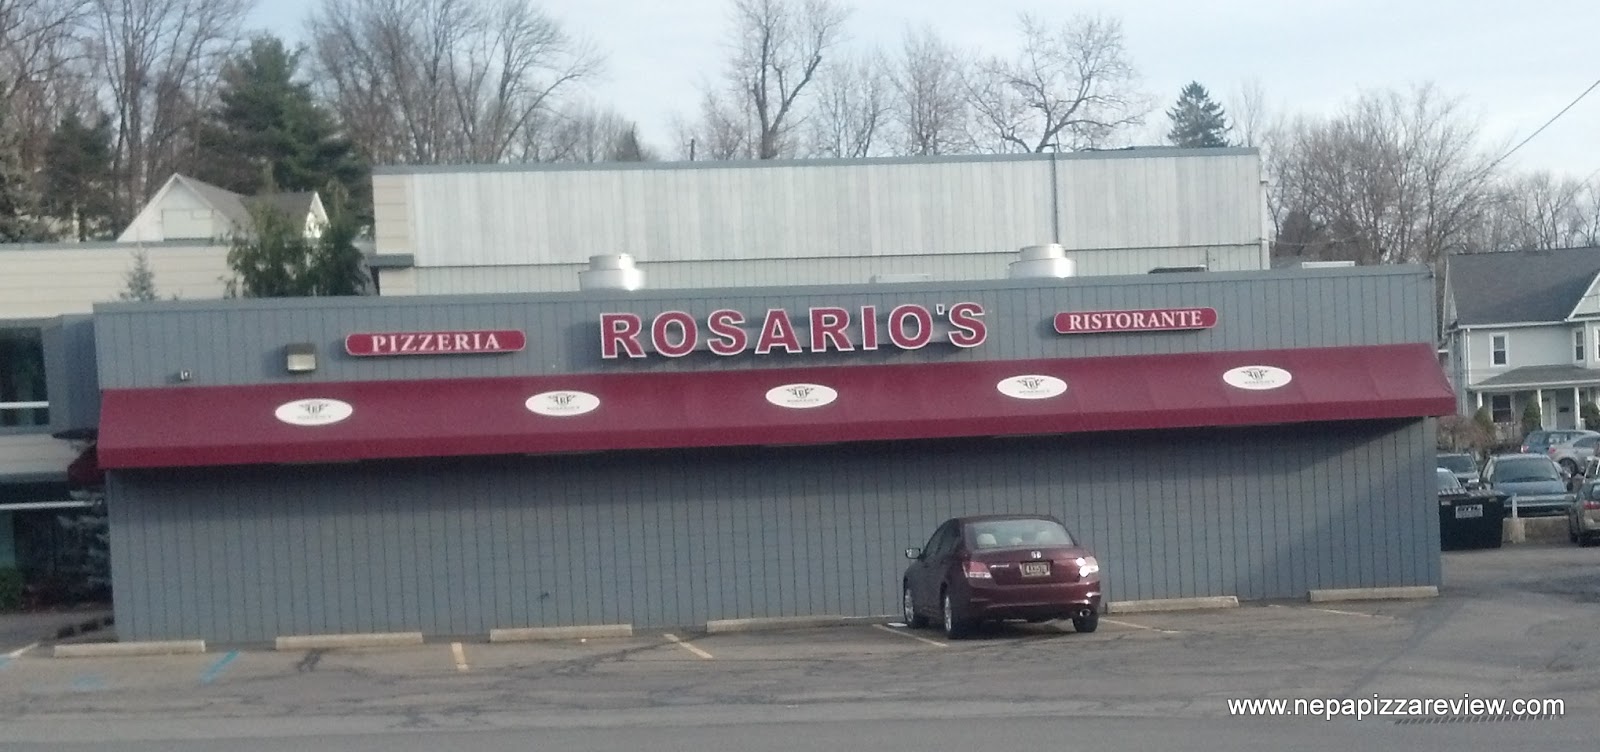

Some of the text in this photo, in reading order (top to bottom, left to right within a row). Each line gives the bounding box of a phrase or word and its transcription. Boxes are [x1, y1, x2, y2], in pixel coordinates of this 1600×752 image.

[600, 302, 988, 359] ROSARIO'S
[1069, 311, 1203, 331] RISTORANTE
[372, 332, 500, 352] PIZZERIA
